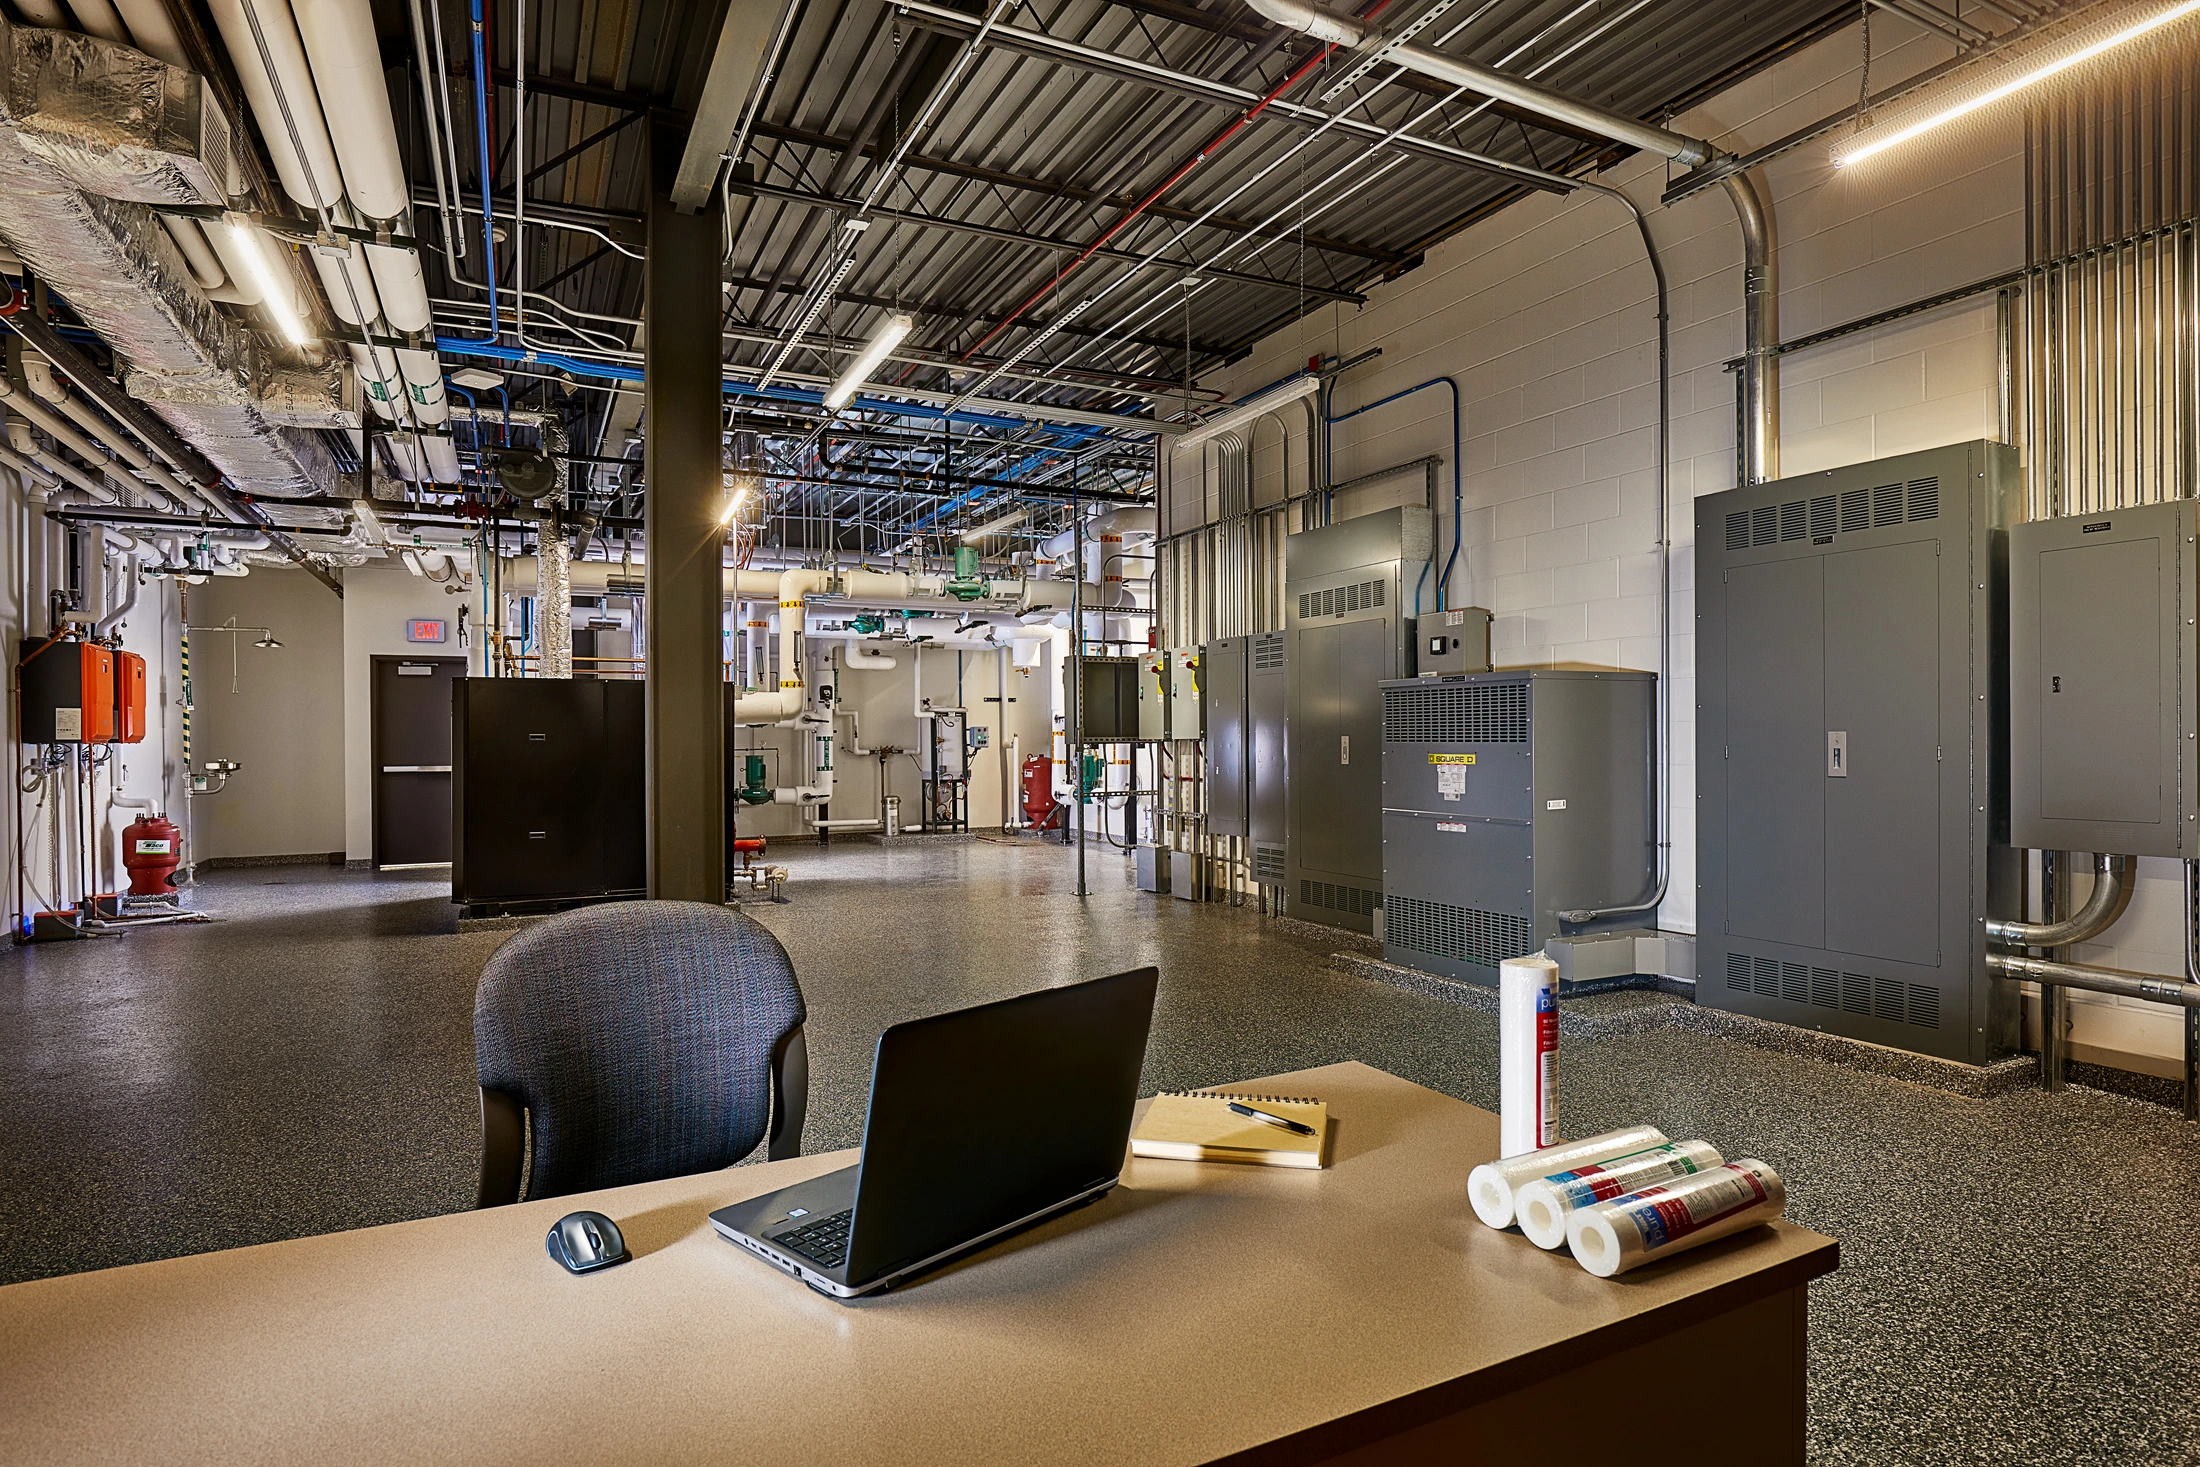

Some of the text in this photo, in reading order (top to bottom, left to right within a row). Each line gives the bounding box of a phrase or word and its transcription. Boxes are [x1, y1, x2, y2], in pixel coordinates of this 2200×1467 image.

[285, 379, 294, 411] Johns
[414, 621, 440, 640] EXIT
[1642, 1206, 1664, 1240] pure
